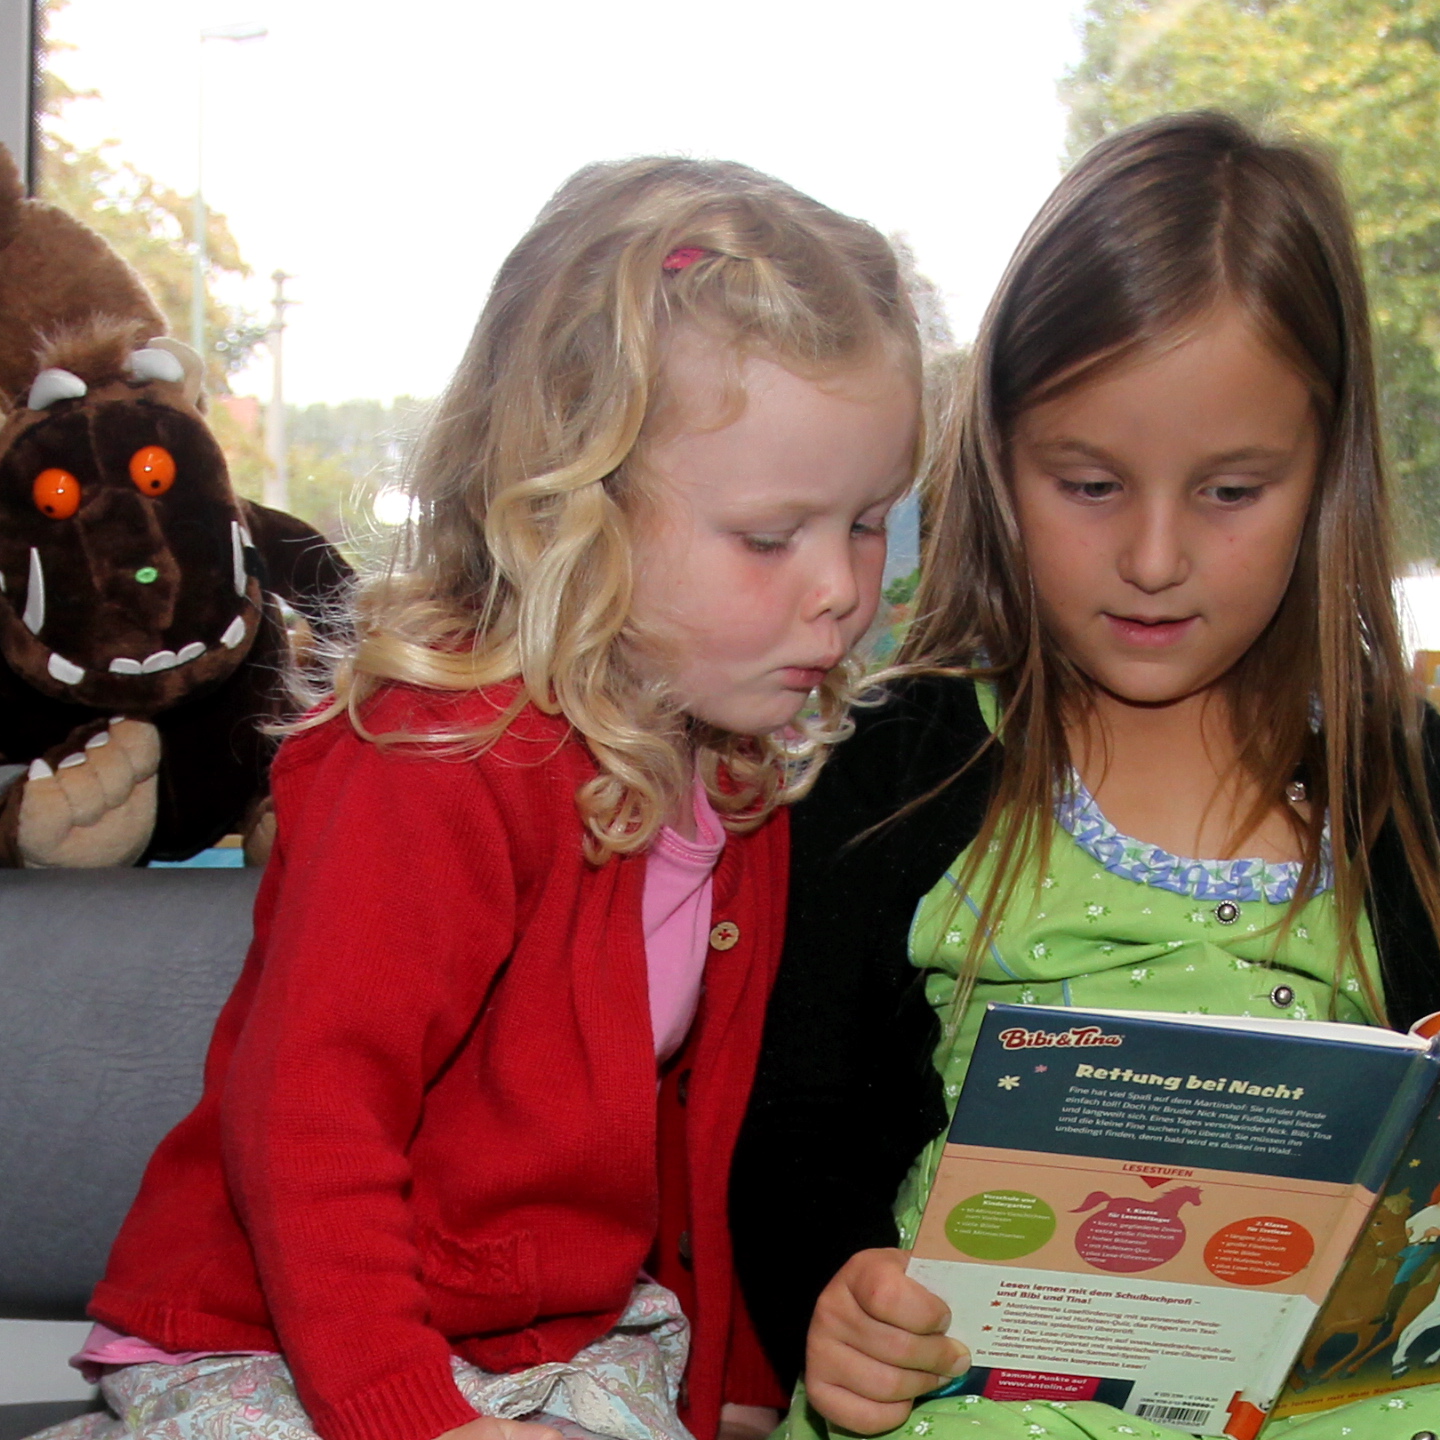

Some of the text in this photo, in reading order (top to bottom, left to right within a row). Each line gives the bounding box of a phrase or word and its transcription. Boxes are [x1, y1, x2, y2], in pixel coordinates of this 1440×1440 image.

[1000, 1028, 1055, 1049] Bibi
[1070, 1027, 1122, 1047] Tina
[1075, 1063, 1305, 1102] Rettung bei Nacht
[1062, 1104, 1080, 1114] und
[1082, 1106, 1124, 1119] langweilt
[1150, 1114, 1174, 1124] Eines
[1176, 1117, 1201, 1127] Tages
[1204, 1120, 1264, 1134] verschwindet
[1313, 1132, 1332, 1142] Tina
[1065, 1095, 1099, 1105] einfach
[1122, 1101, 1146, 1111] Doch
[1149, 1104, 1160, 1112] ihr
[1163, 1105, 1195, 1116] Bruder
[1197, 1109, 1215, 1118] Nick
[1218, 1112, 1239, 1121] mag
[1241, 1114, 1275, 1125] Fußball
[1277, 1118, 1293, 1127] viel
[1295, 1120, 1321, 1130] lieber
[1249, 1105, 1326, 1121] Sie findet Pferde
[1058, 1113, 1077, 1122] und
[1080, 1116, 1092, 1124] die
[1095, 1117, 1122, 1127] kleine
[1125, 1121, 1145, 1130] Fine
[1148, 1123, 1179, 1134] suchen
[1181, 1127, 1196, 1136] ihn
[1234, 1133, 1248, 1142] Sie
[1250, 1135, 1285, 1146] müssen
[1287, 1139, 1302, 1148] ihn
[1121, 1162, 1193, 1178] LESESTUFEN
[996, 1289, 1091, 1304] und Bibi und Tina!
[1000, 1280, 1192, 1305] Lesen lernen mit dem Schulbuchprofi
[998, 1378, 1078, 1392] www.antolin.de
[1000, 1370, 1088, 1385] Sammle Punkte auf
